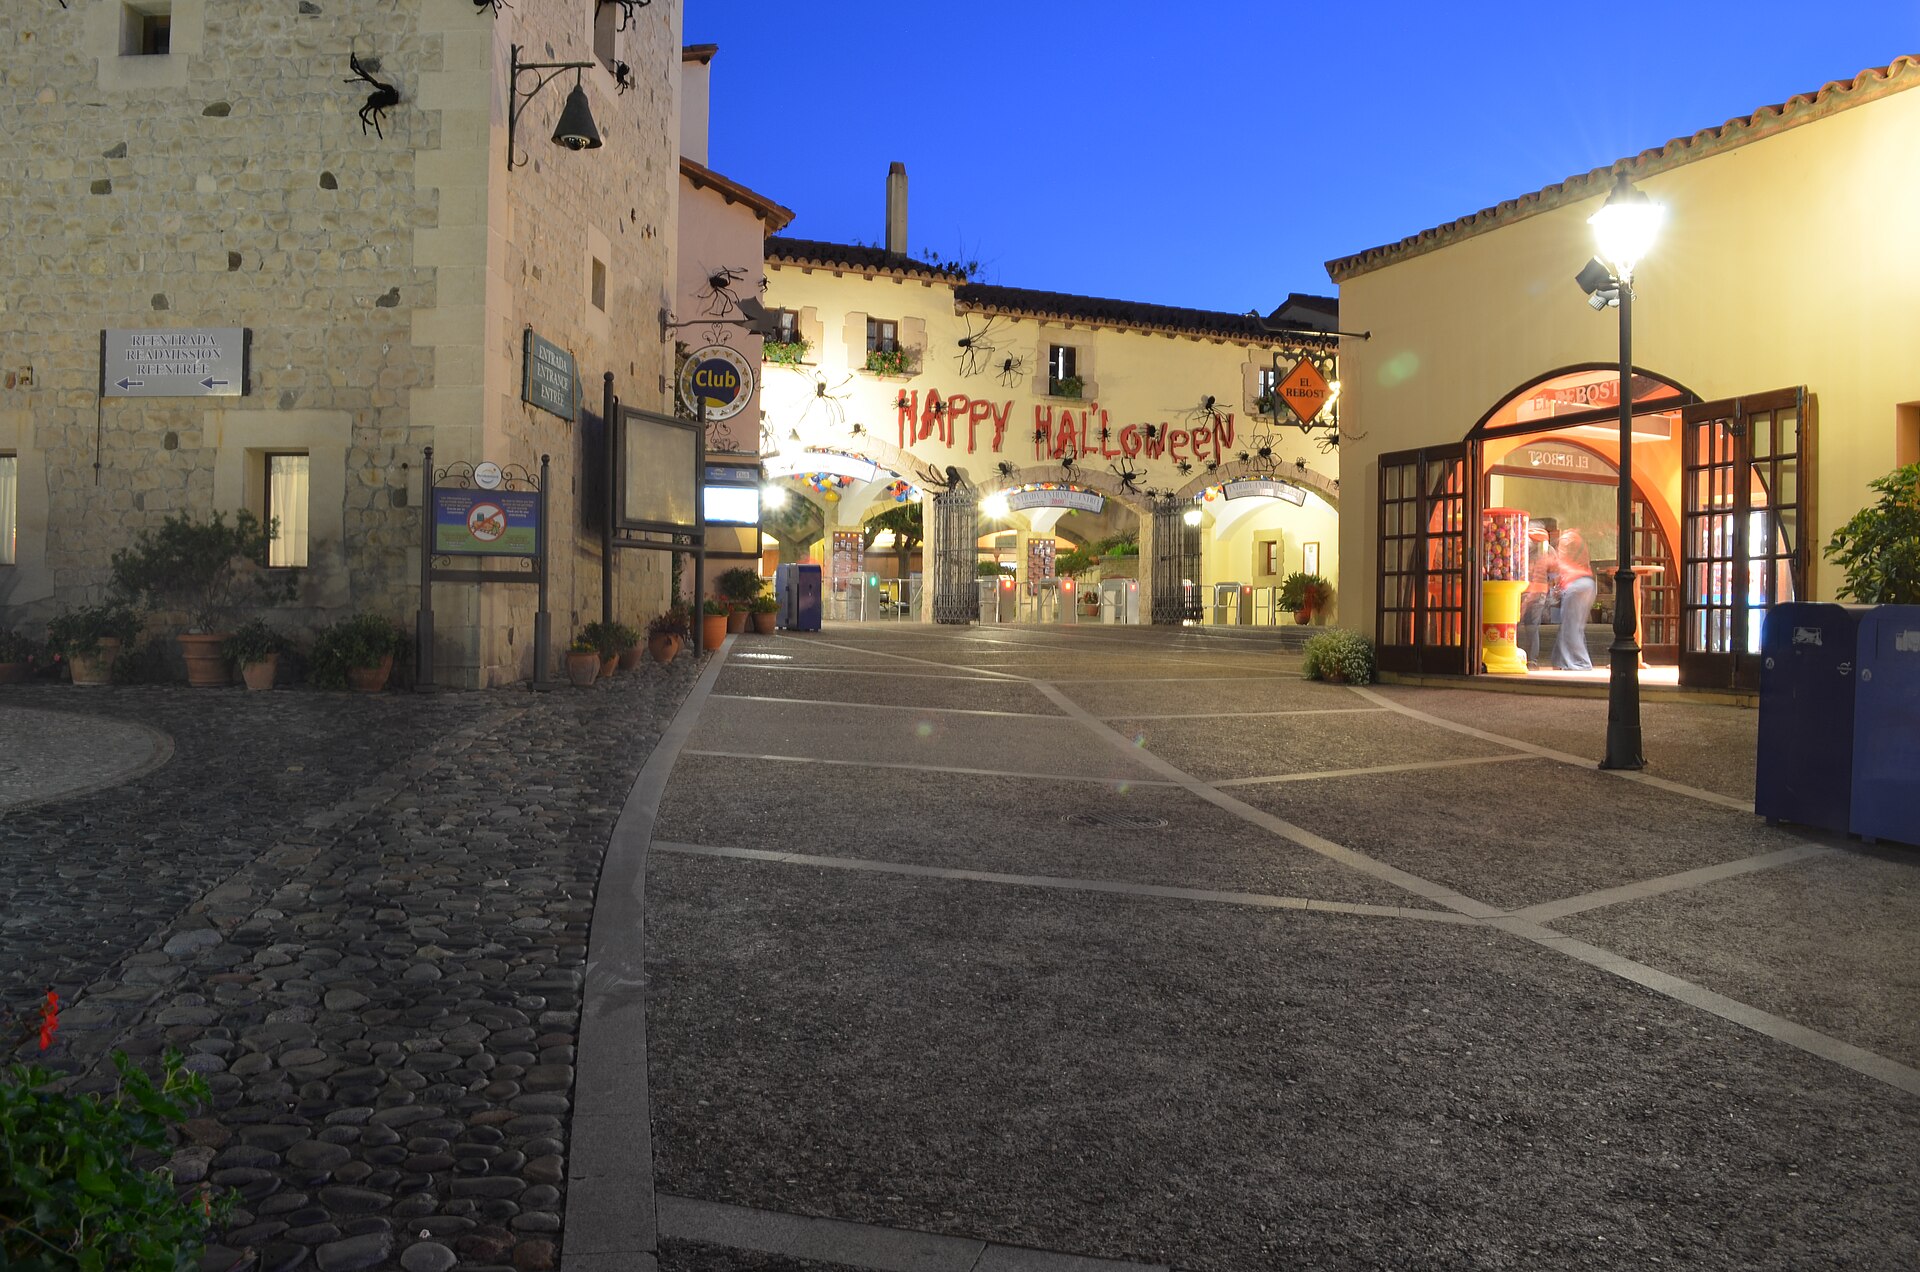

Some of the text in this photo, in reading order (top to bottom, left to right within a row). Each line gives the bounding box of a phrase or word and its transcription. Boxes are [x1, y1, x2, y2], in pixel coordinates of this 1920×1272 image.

[131, 334, 217, 346] REENTRADA
[125, 348, 222, 361] READMISSION
[539, 345, 568, 373] ENTRADA
[537, 362, 569, 391] ENTRANCE
[695, 369, 736, 388] Club
[1300, 378, 1312, 387] EL
[1286, 387, 1326, 399] REBOST
[1554, 380, 1619, 404] REBOST
[897, 387, 1013, 455] HAPPY
